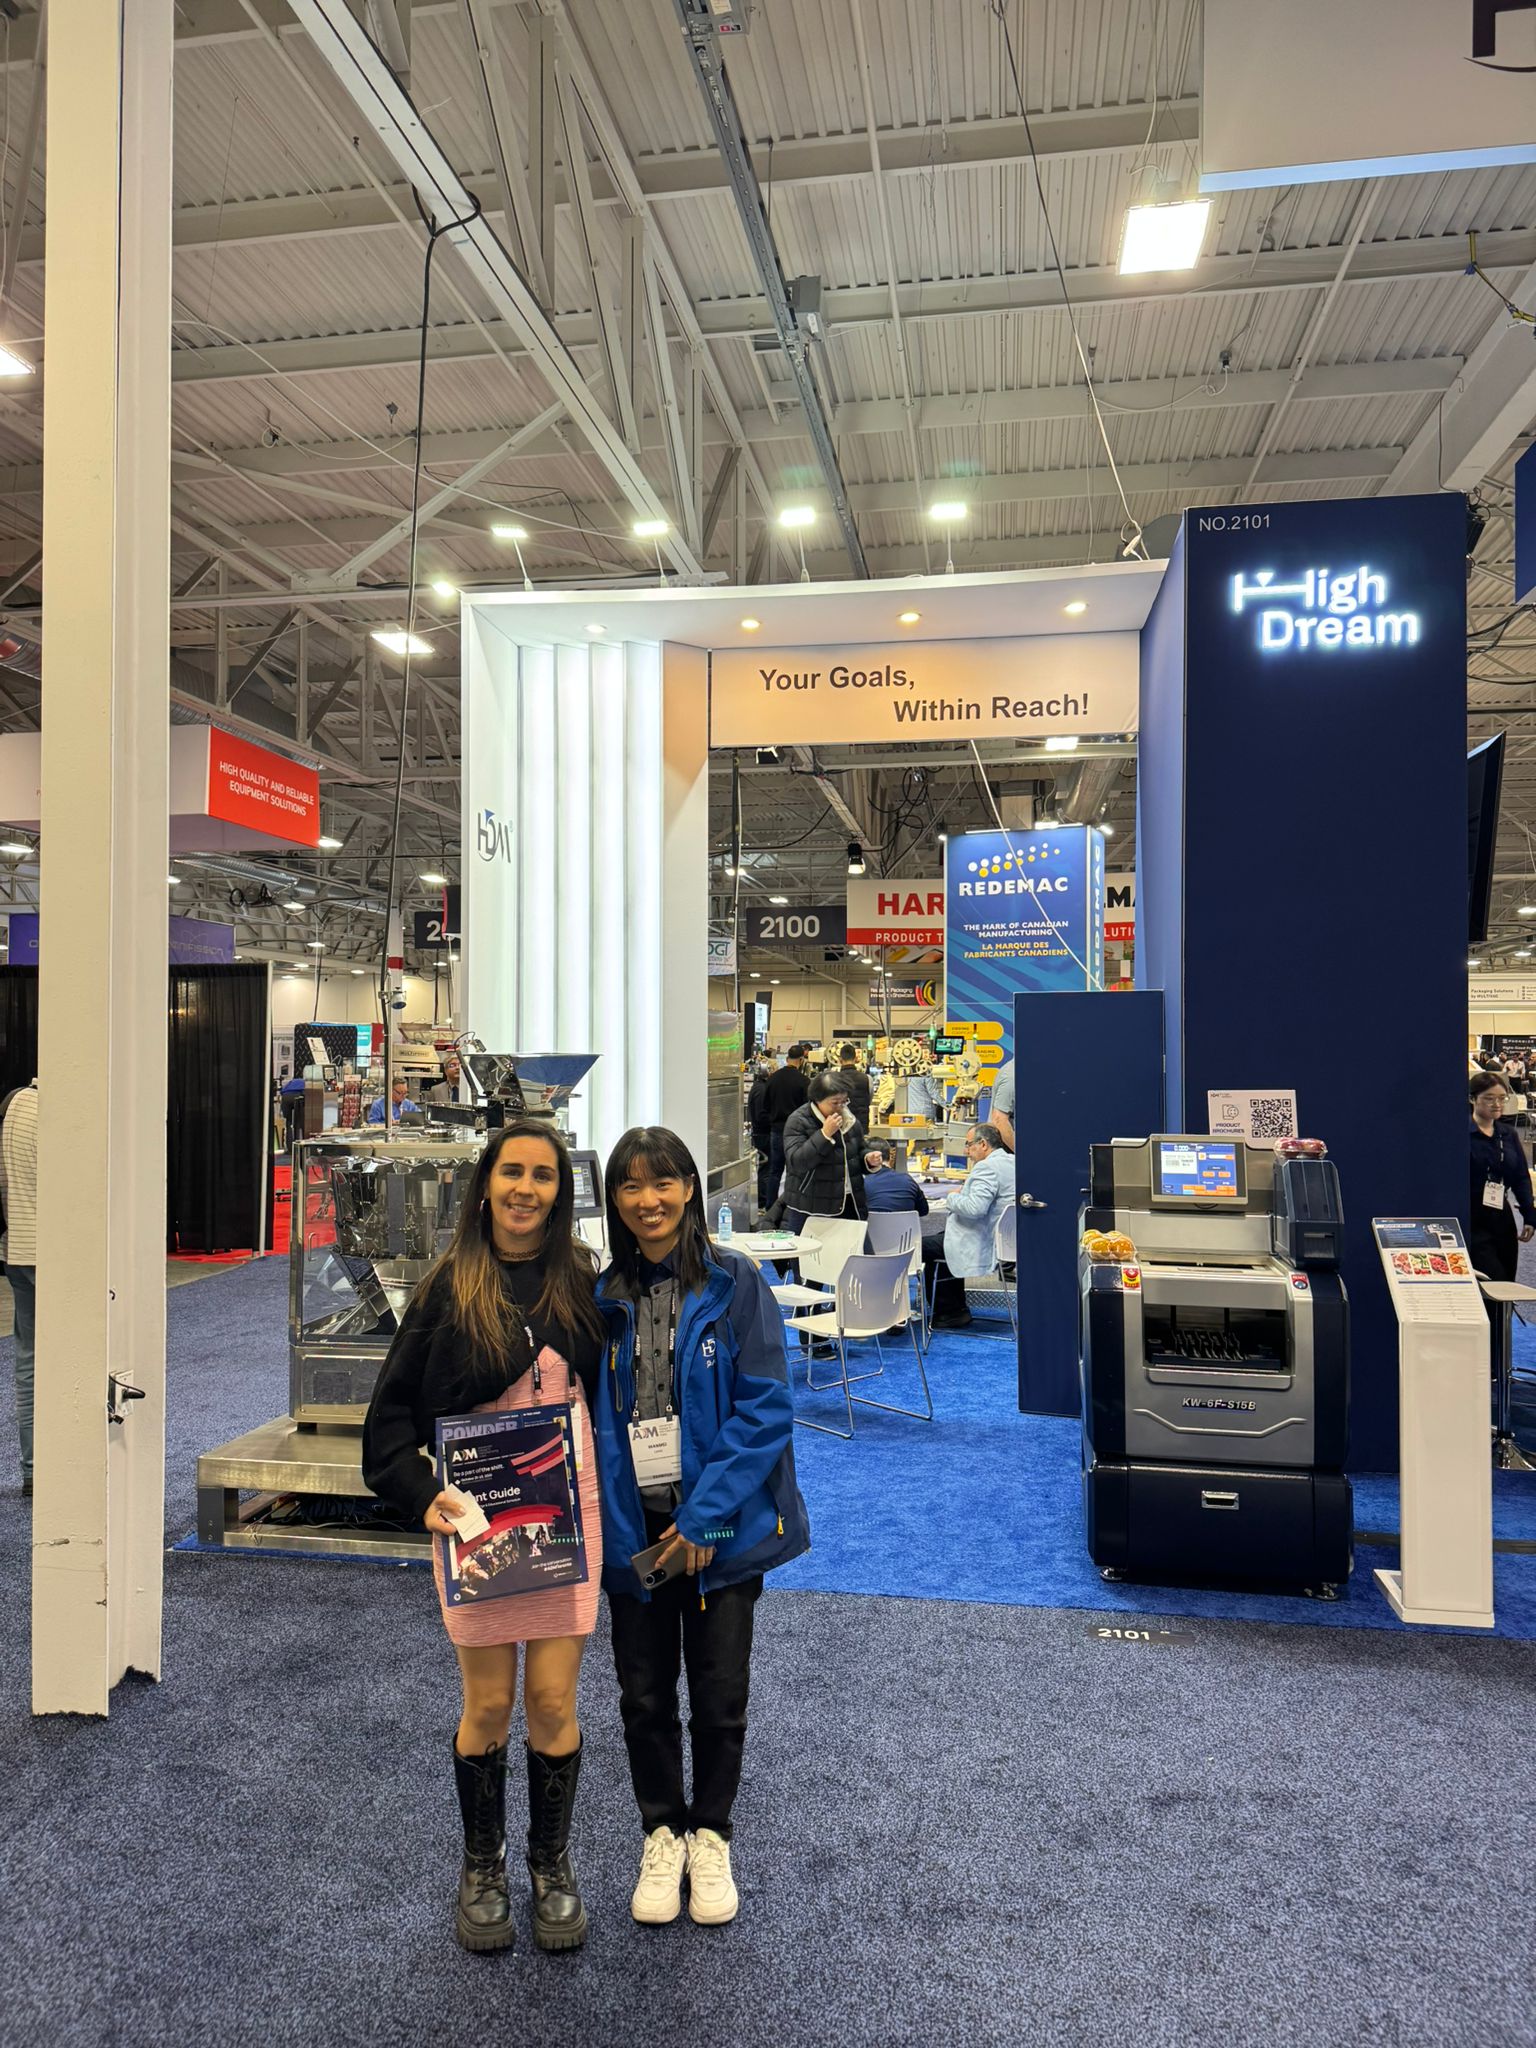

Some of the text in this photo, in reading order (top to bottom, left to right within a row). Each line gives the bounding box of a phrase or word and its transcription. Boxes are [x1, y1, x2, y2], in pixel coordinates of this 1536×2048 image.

[1199, 514, 1270, 532] NO.2101
[1233, 566, 1386, 614] High
[1261, 610, 1419, 648] Dream
[759, 665, 916, 691] Your Goals,
[893, 693, 1089, 722] Within Reach!
[219, 761, 315, 805] HIGH QUALITY AND RELIABLE
[229, 780, 307, 816] EQUIPMENT SOLUTIONS
[958, 877, 1069, 896] REDEMAC
[759, 915, 820, 938] 2100
[978, 929, 1053, 938] MANUFACTURING
[1009, 922, 1020, 930] OF
[1021, 920, 1069, 930] CANADIAN
[875, 932, 931, 943] PRODUCT
[981, 941, 1049, 952] LA MARQUE DES
[964, 949, 1069, 959] FABRICANTS CANADIENS
[488, 1486, 521, 1500] Guide
[1097, 1628, 1150, 1641] 2101
